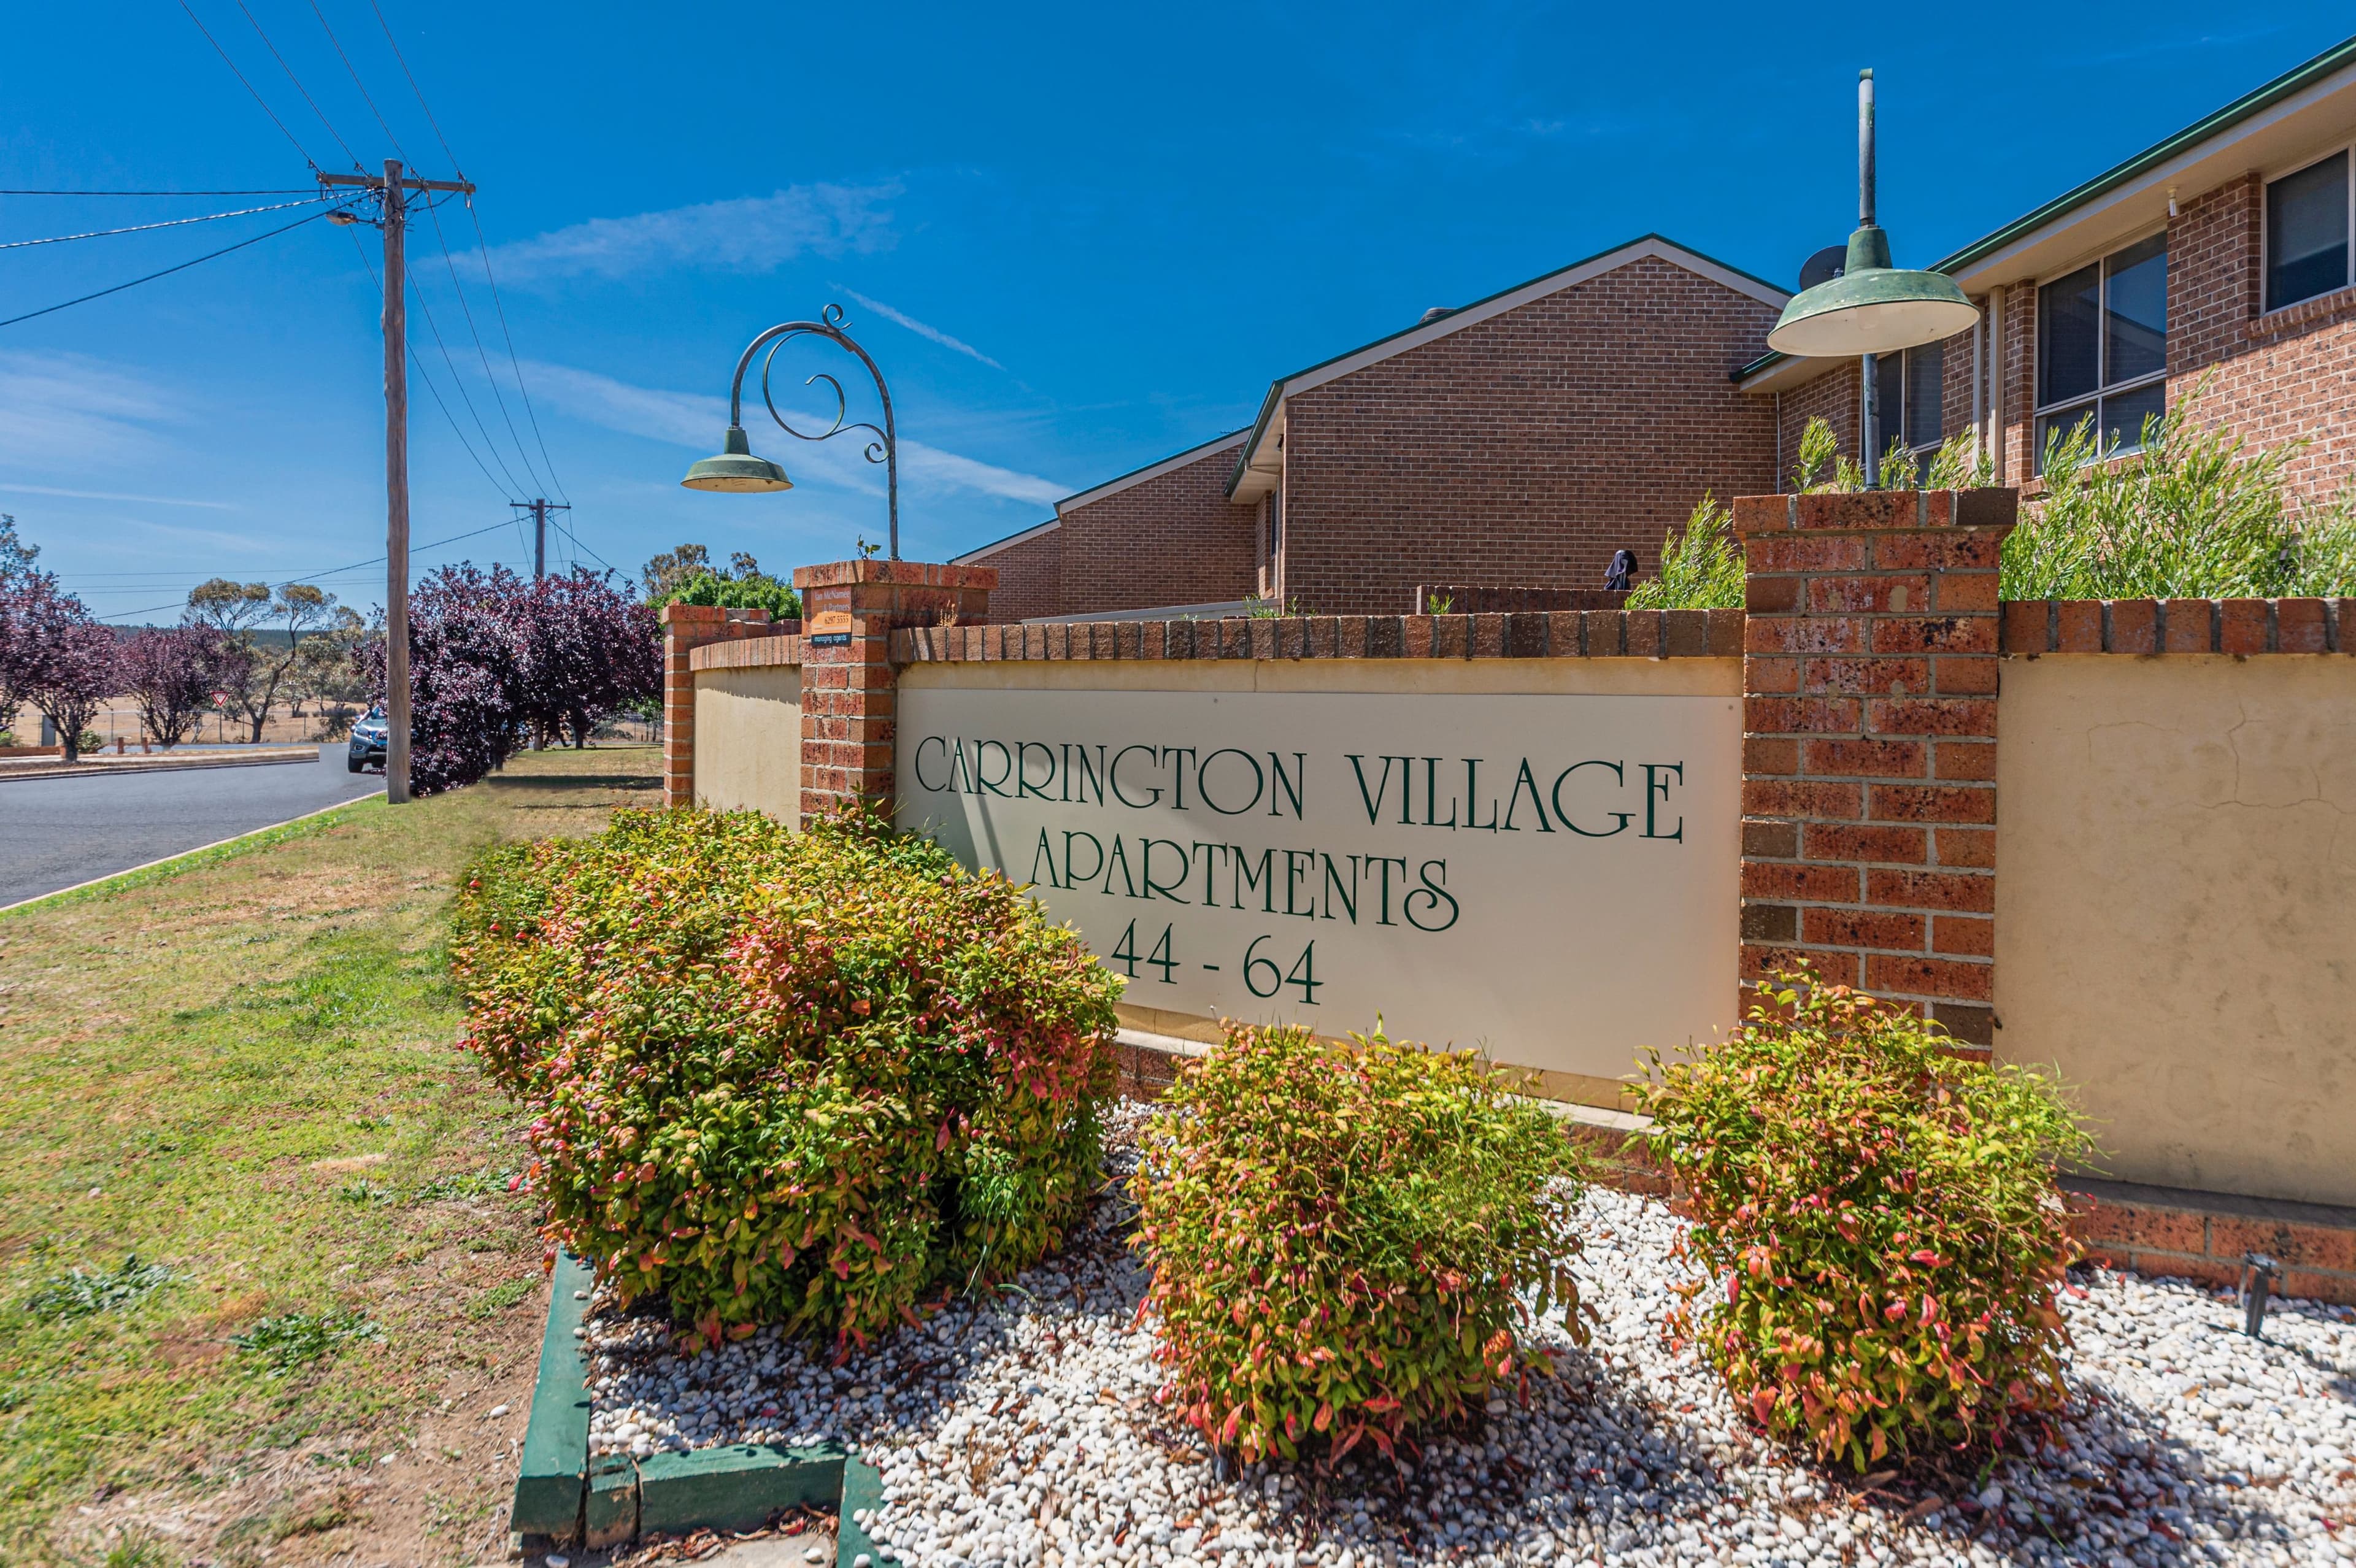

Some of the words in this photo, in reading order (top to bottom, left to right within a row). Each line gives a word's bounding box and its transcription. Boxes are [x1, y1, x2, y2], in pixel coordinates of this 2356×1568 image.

[914, 736, 1307, 821] CARRINGTON
[1344, 754, 1684, 844] VILLAGE
[1031, 826, 1460, 933] APARTMENTS
[1111, 918, 1180, 985] 44
[1243, 935, 1323, 1007] 64
